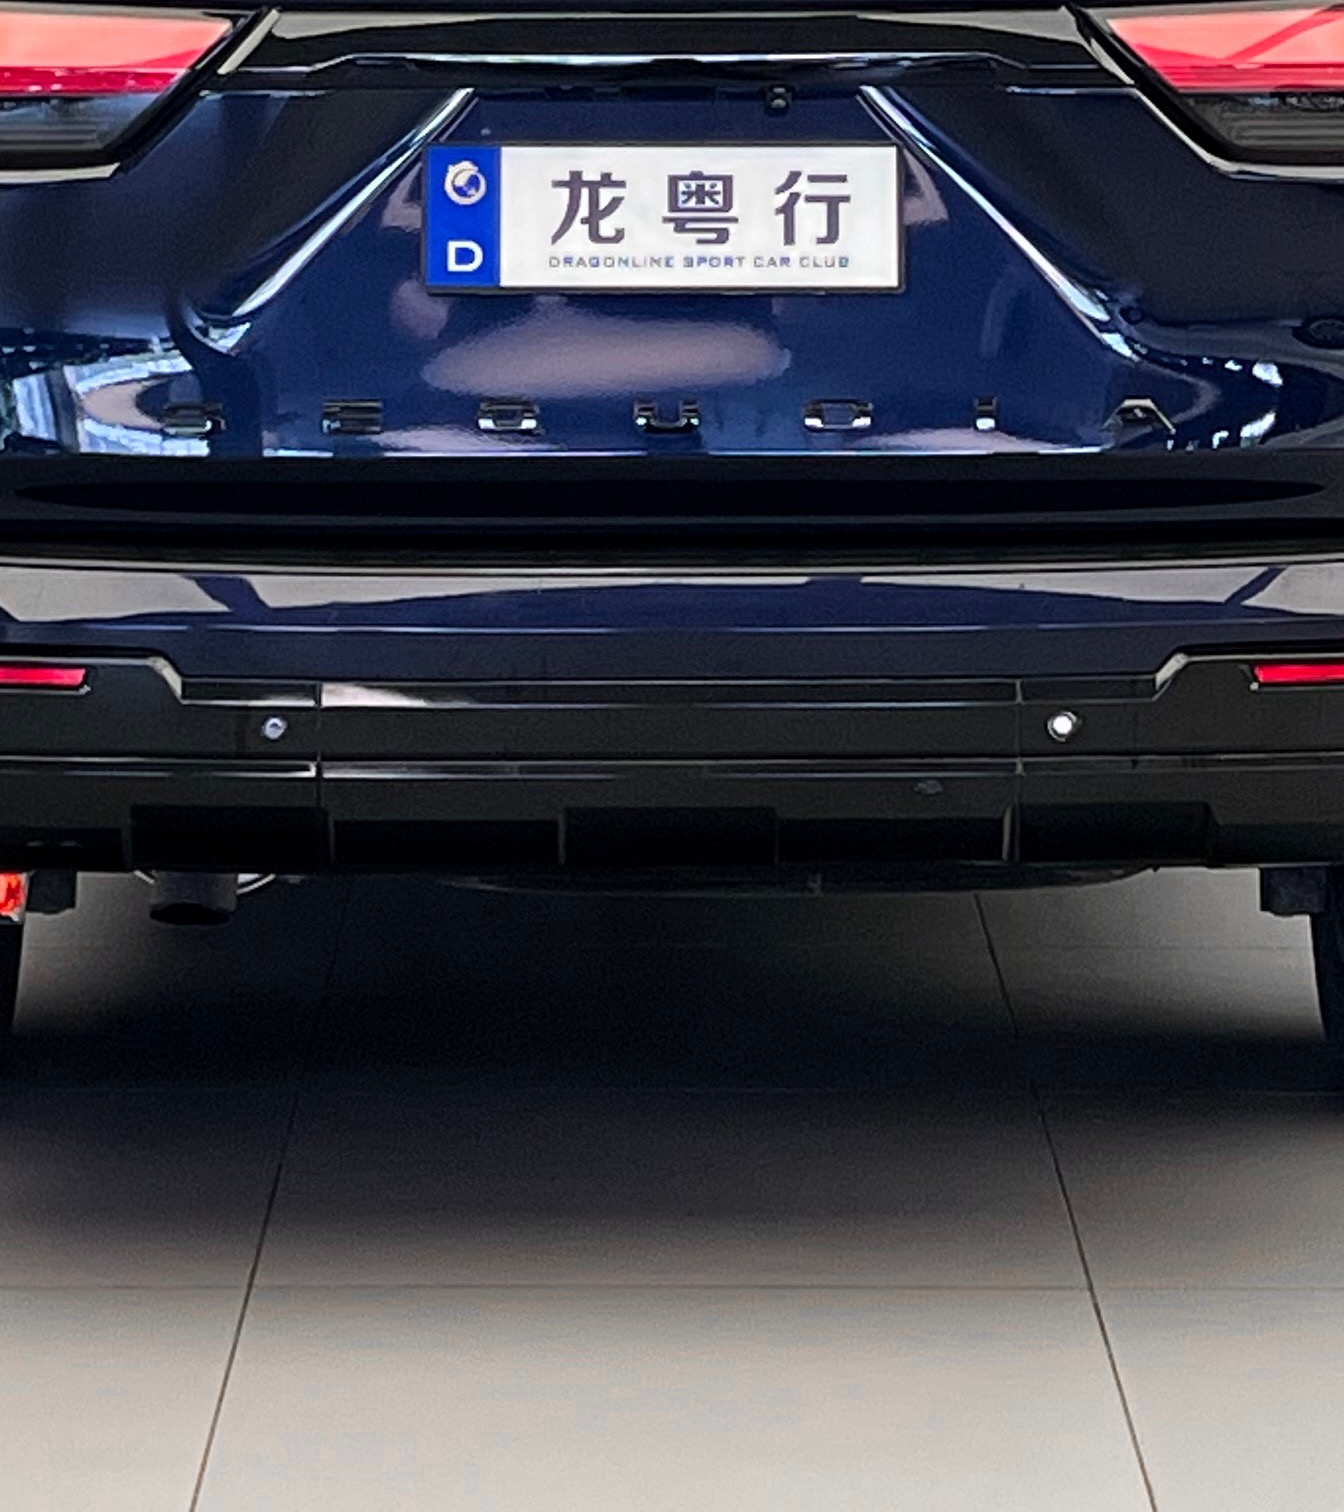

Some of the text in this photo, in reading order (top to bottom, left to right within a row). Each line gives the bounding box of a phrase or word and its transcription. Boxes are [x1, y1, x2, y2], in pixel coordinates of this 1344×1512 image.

[551, 170, 851, 246] 龙粤行
[447, 240, 483, 272] D
[548, 255, 851, 268] DRAGONLINE SPORT CAR CLUB
